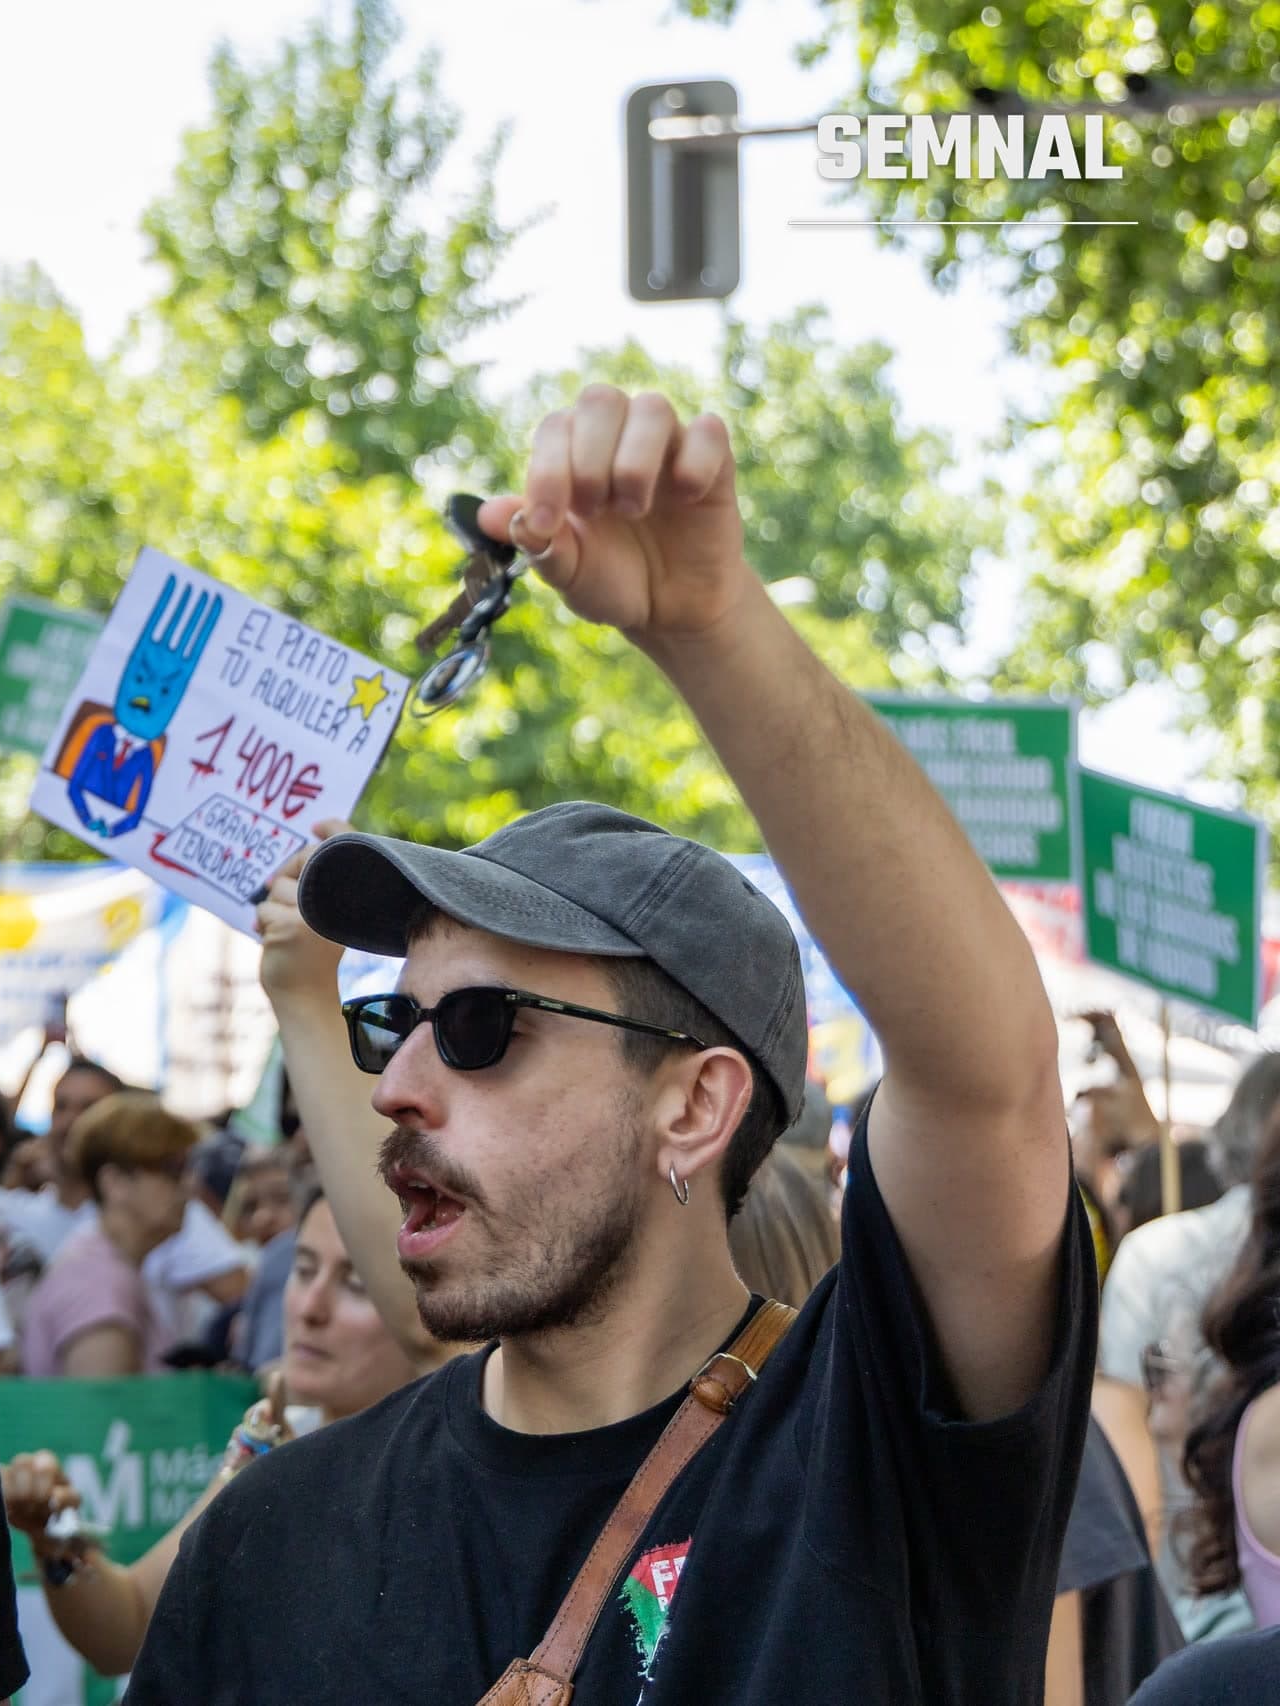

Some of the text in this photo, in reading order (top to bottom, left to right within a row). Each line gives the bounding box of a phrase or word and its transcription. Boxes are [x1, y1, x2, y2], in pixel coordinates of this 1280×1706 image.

[236, 607, 349, 686] EL PLATO
[219, 645, 371, 755] TU ALQUILER A
[173, 822, 263, 899] TENEDORES
[204, 800, 282, 868] GRANDES
